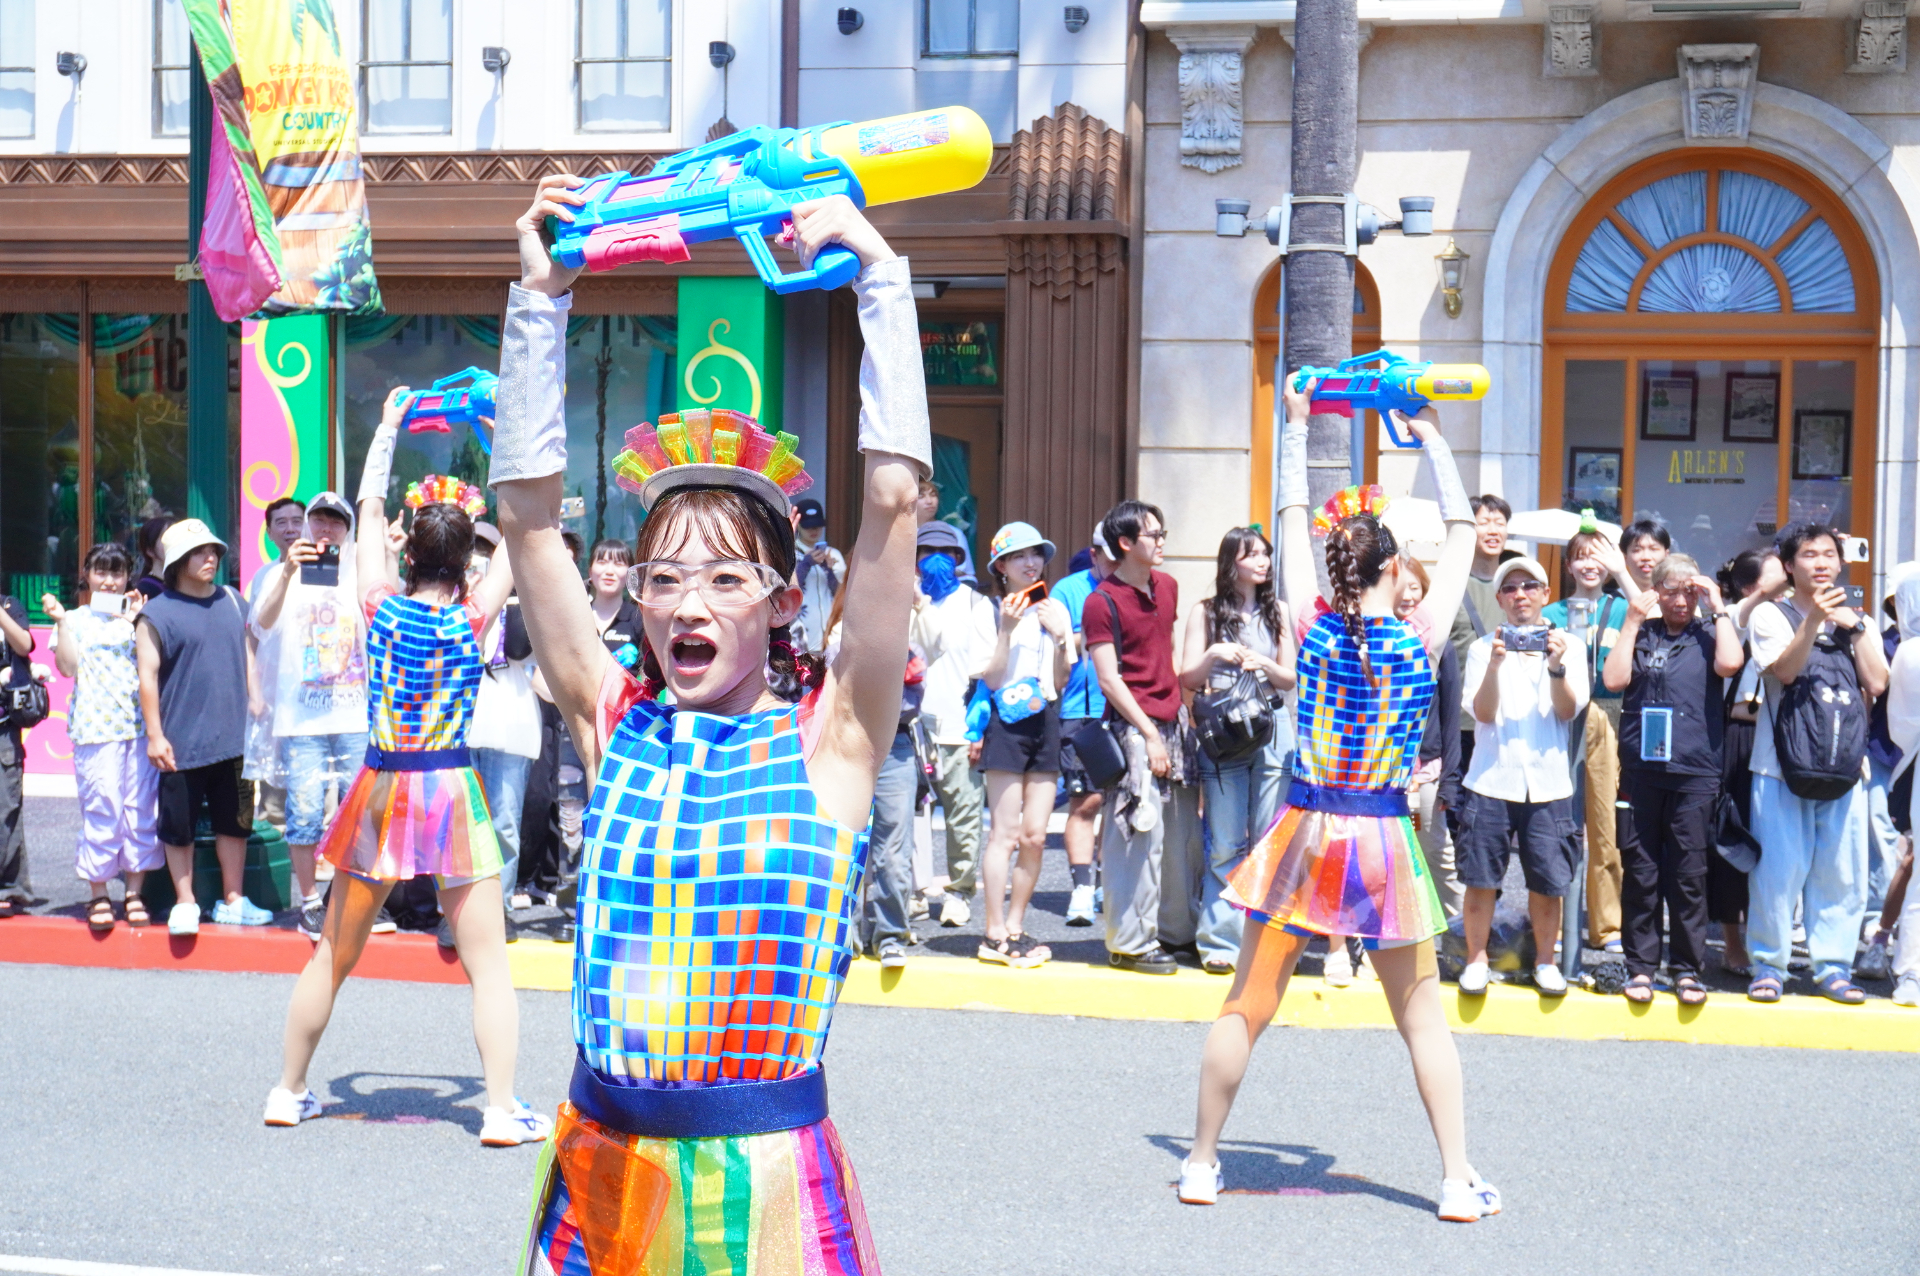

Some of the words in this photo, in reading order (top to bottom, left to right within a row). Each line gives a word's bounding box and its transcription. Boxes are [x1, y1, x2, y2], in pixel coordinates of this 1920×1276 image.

[243, 77, 323, 114] DONKEY
[328, 79, 355, 109] KO
[282, 112, 347, 131] COUNTRY
[273, 138, 310, 146] UNIVERSAL
[1668, 450, 1745, 483] ARLEN'S
